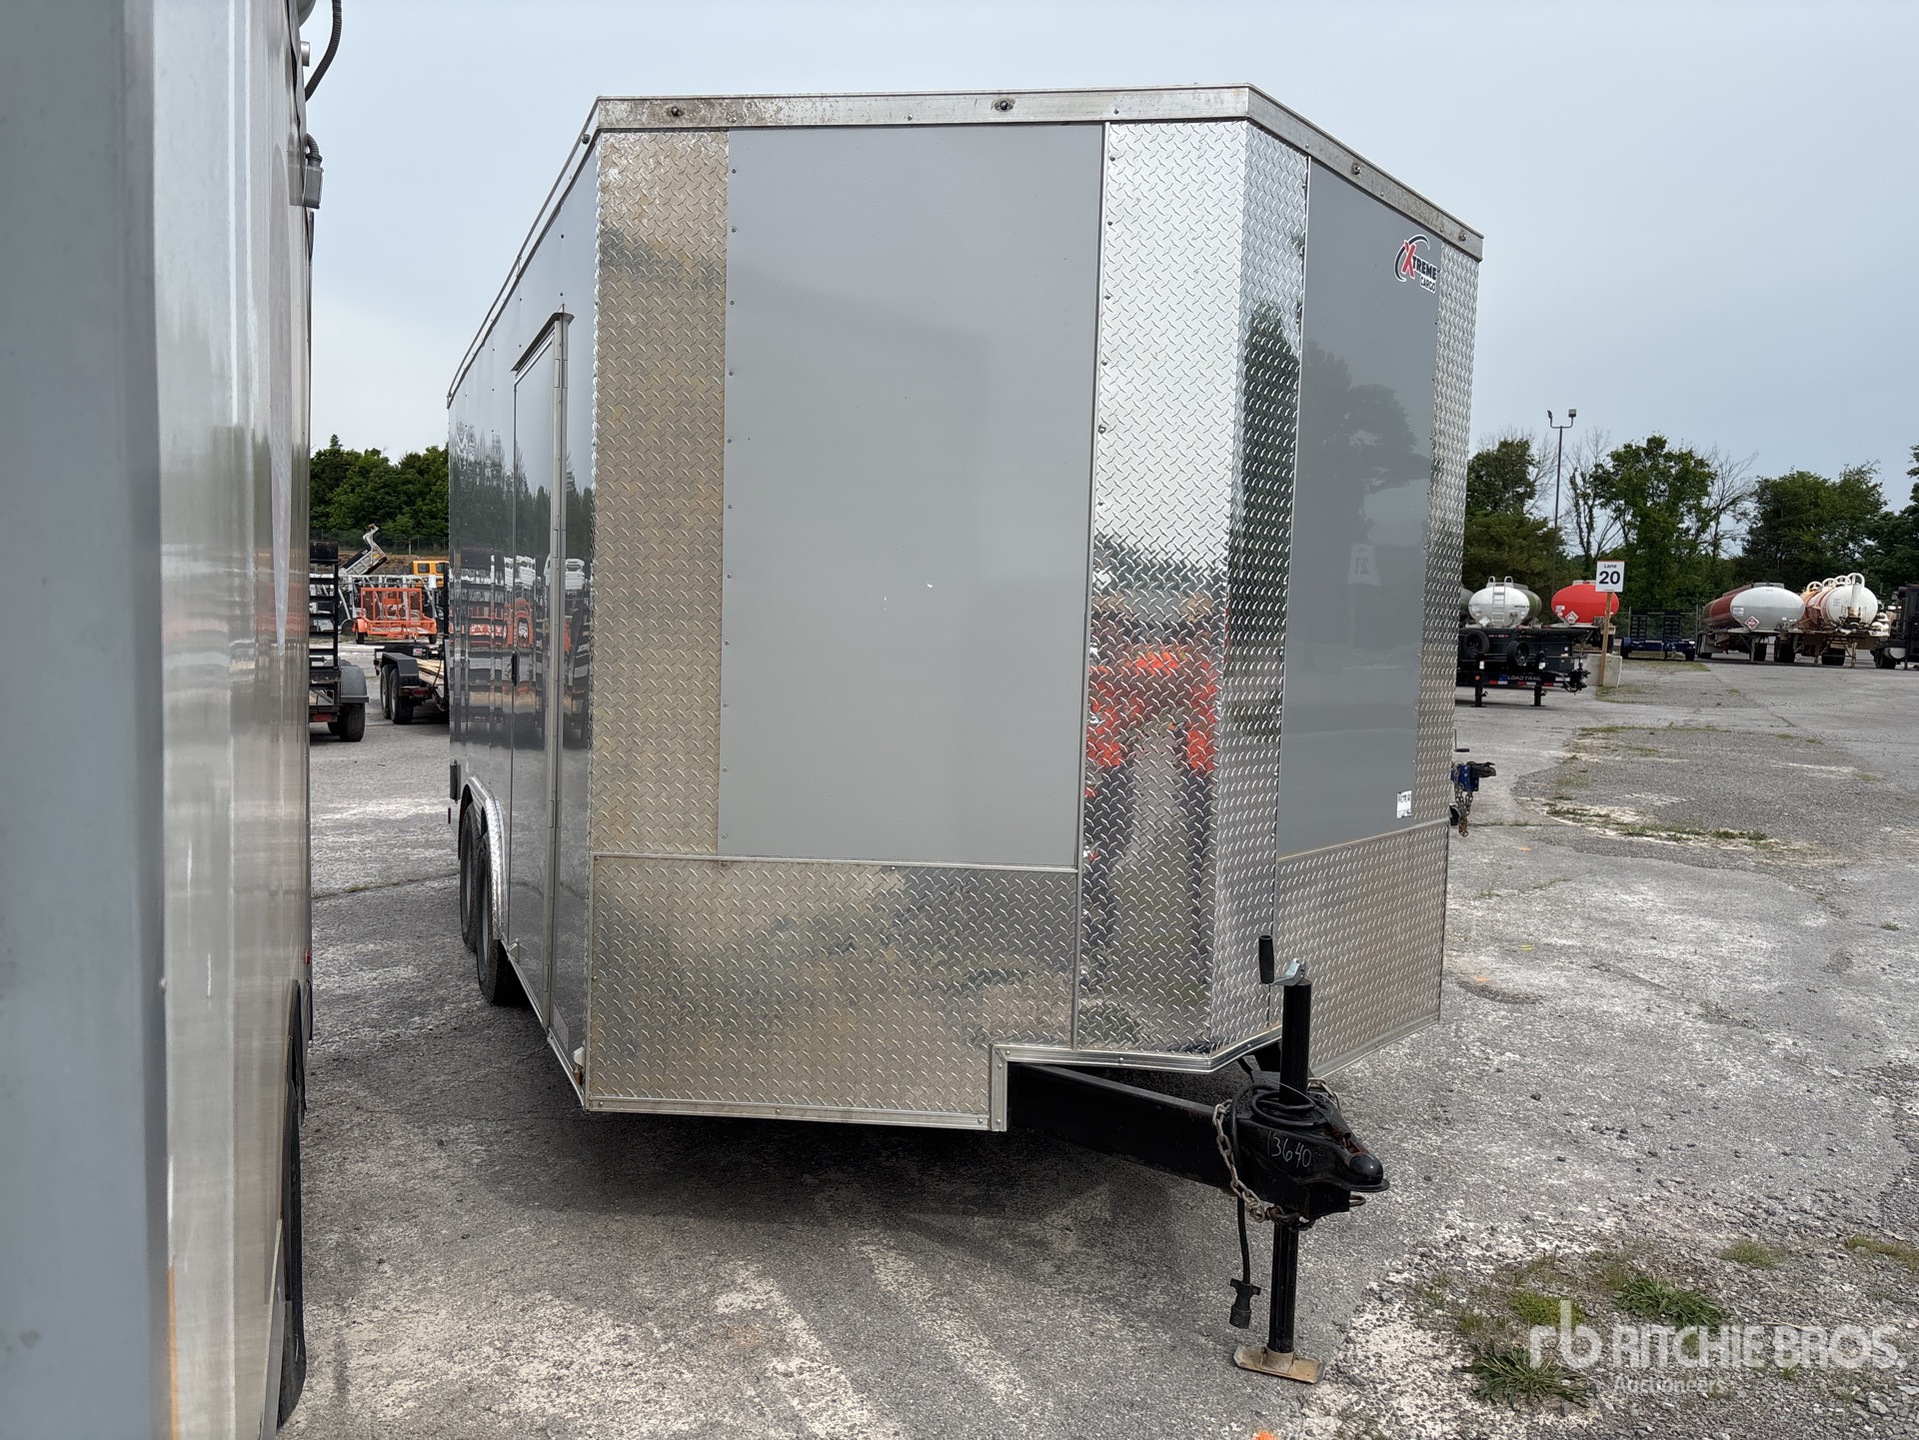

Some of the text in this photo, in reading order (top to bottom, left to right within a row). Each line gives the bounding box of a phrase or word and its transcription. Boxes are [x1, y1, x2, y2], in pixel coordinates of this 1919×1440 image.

[1401, 240, 1437, 280] XTREME
[1599, 571, 1621, 585] 20
[1267, 1130, 1312, 1169] 13640
